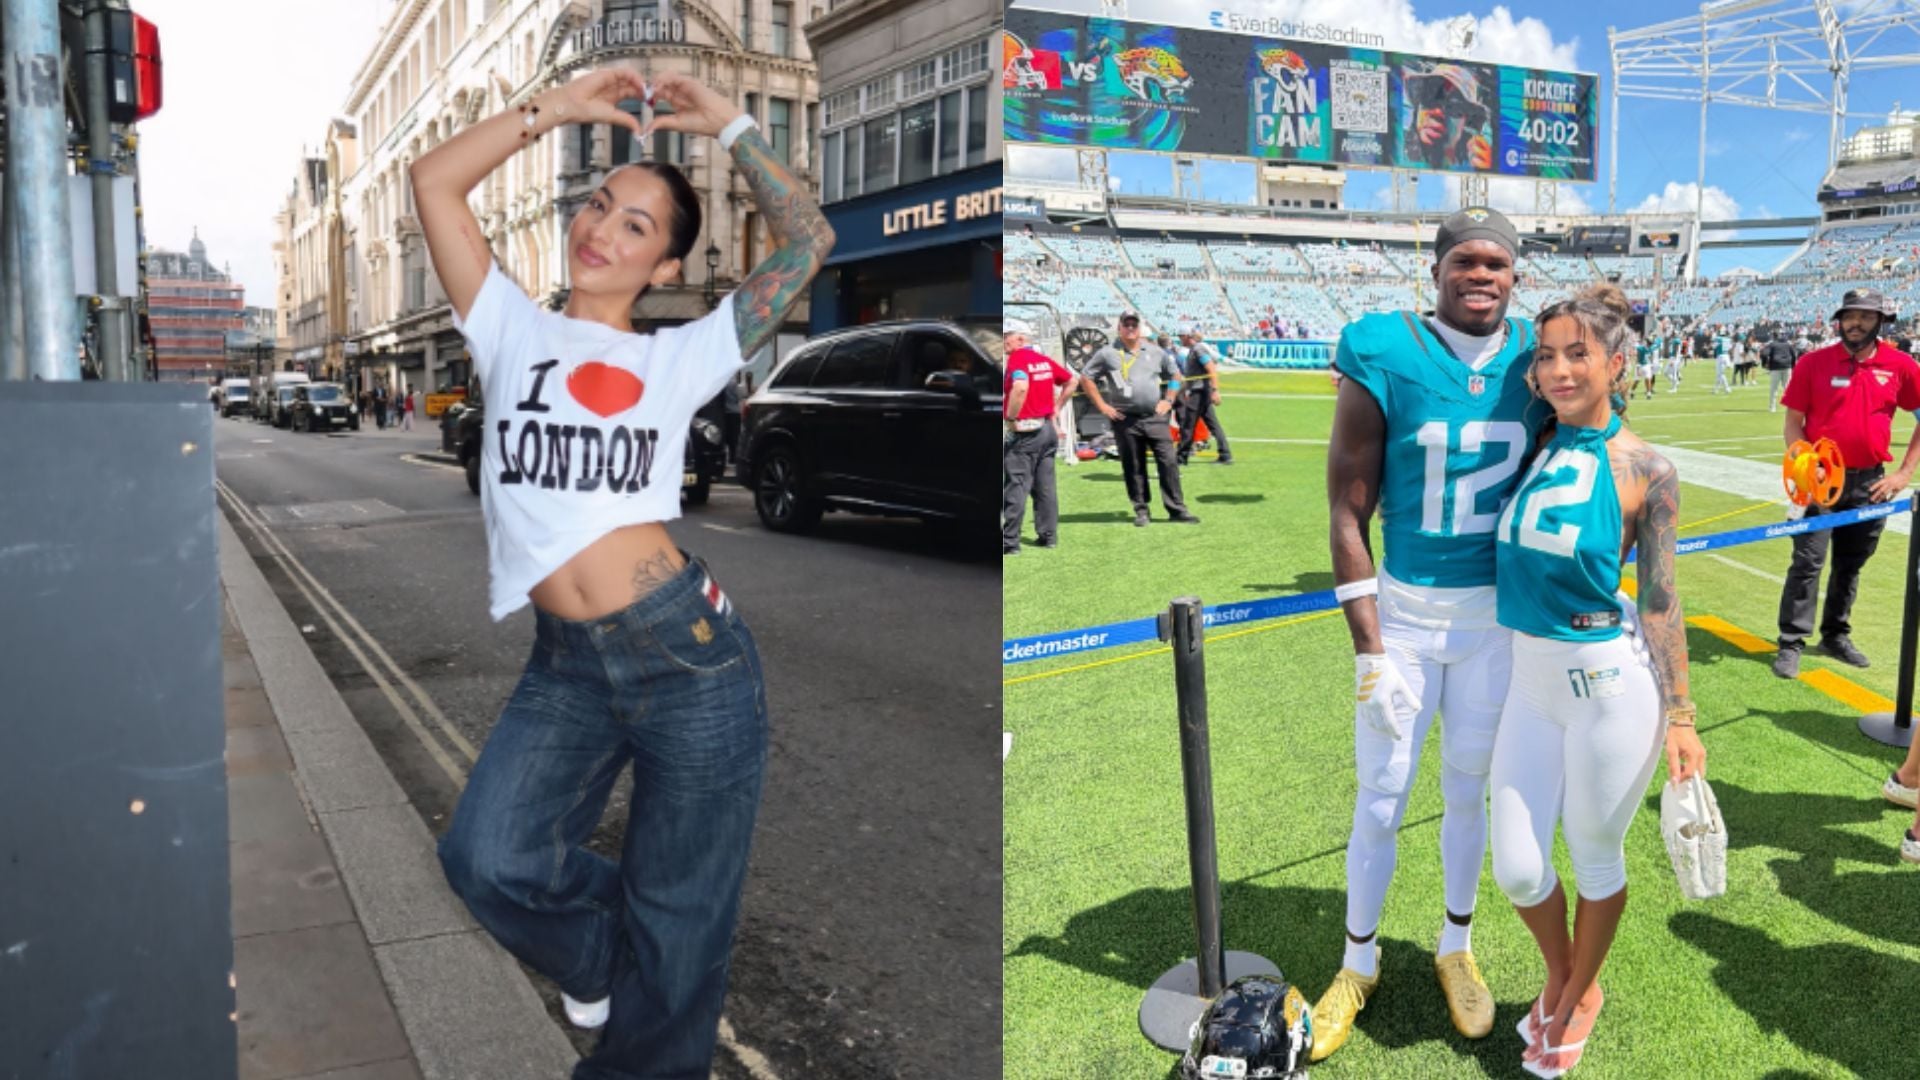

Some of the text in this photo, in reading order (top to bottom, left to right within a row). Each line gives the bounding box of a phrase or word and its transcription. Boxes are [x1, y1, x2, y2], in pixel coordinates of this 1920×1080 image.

[1068, 61, 1097, 82] VS
[1523, 78, 1577, 102] KICKOFF
[1254, 76, 1317, 114] FAN
[1255, 114, 1321, 148] CAM
[1518, 118, 1579, 146] 40:02
[883, 199, 948, 237] LITTLE
[516, 359, 559, 413] I
[497, 419, 659, 494] LONDON
[1417, 421, 1527, 536] 12
[1497, 449, 1601, 558] 12
